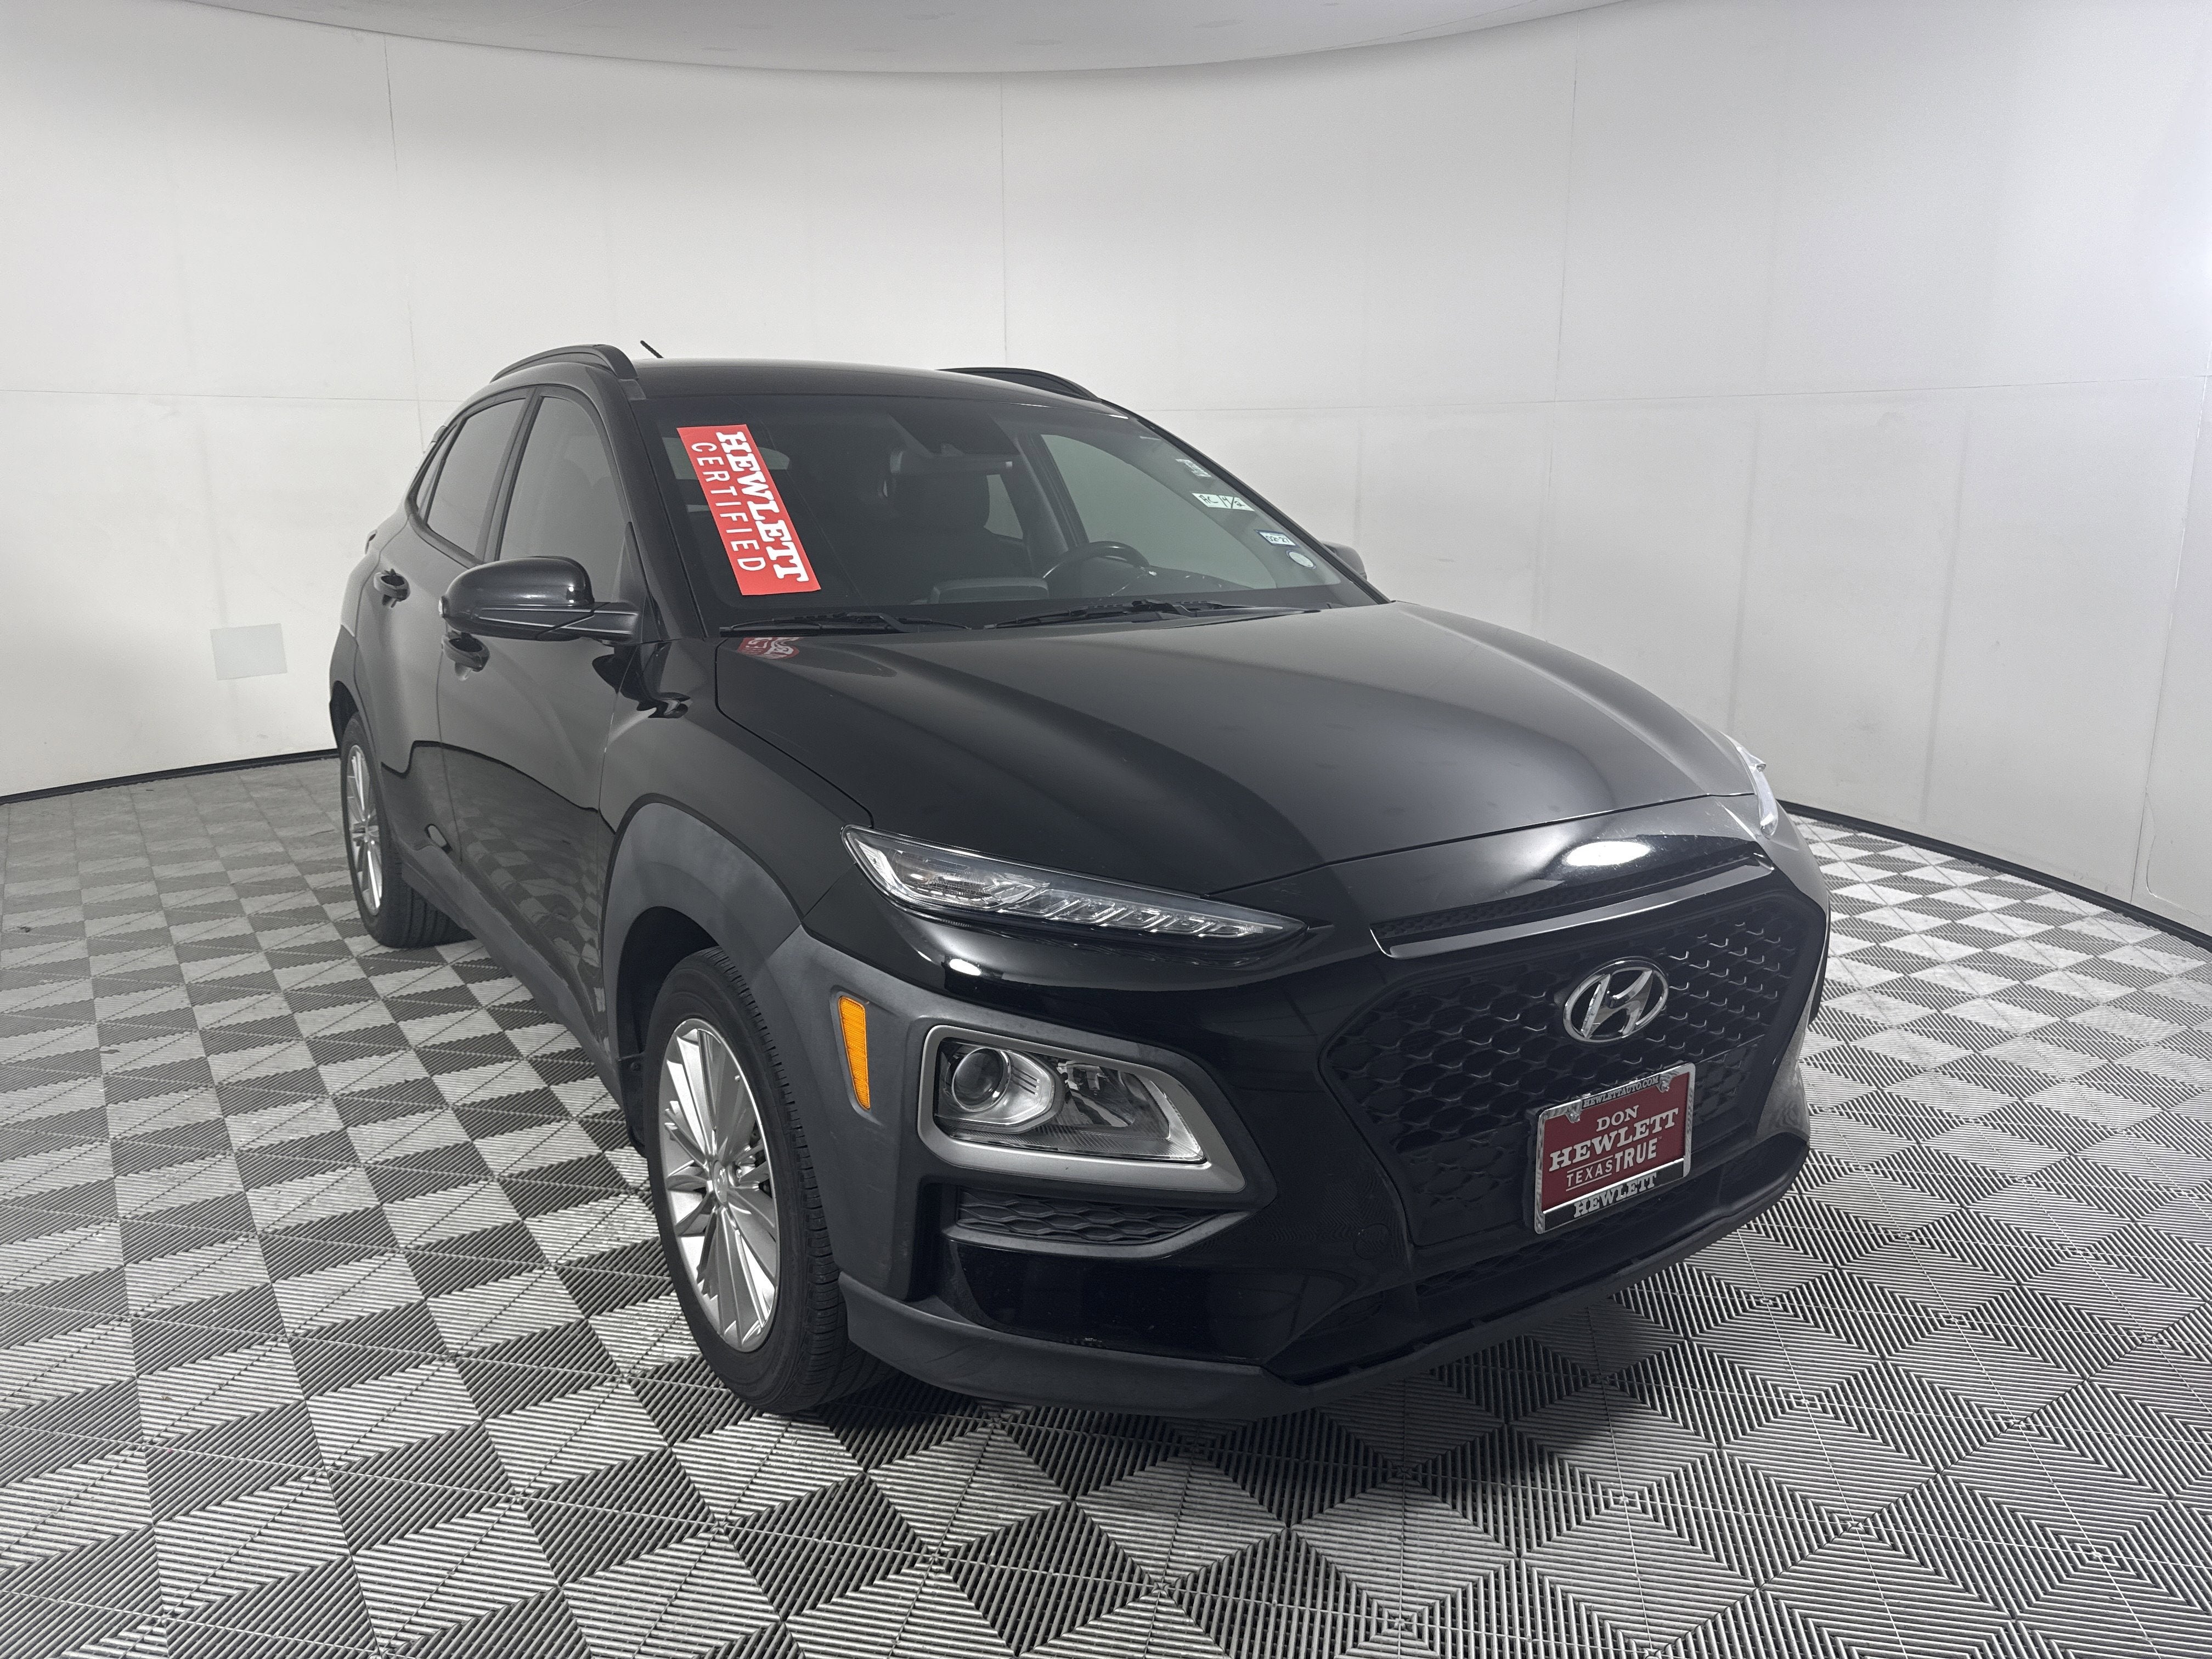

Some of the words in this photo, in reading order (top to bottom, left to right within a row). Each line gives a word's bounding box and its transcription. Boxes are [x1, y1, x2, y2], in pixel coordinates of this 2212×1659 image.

[691, 442, 766, 571] CERTIFIED
[715, 431, 809, 582] HEWLETT
[1583, 1075, 1659, 1108] HEWLETTAUTO.COM
[1596, 1104, 1639, 1132] DON
[1549, 1107, 1679, 1172] HEWLETT
[1573, 1172, 1657, 1218] HEWLETT
